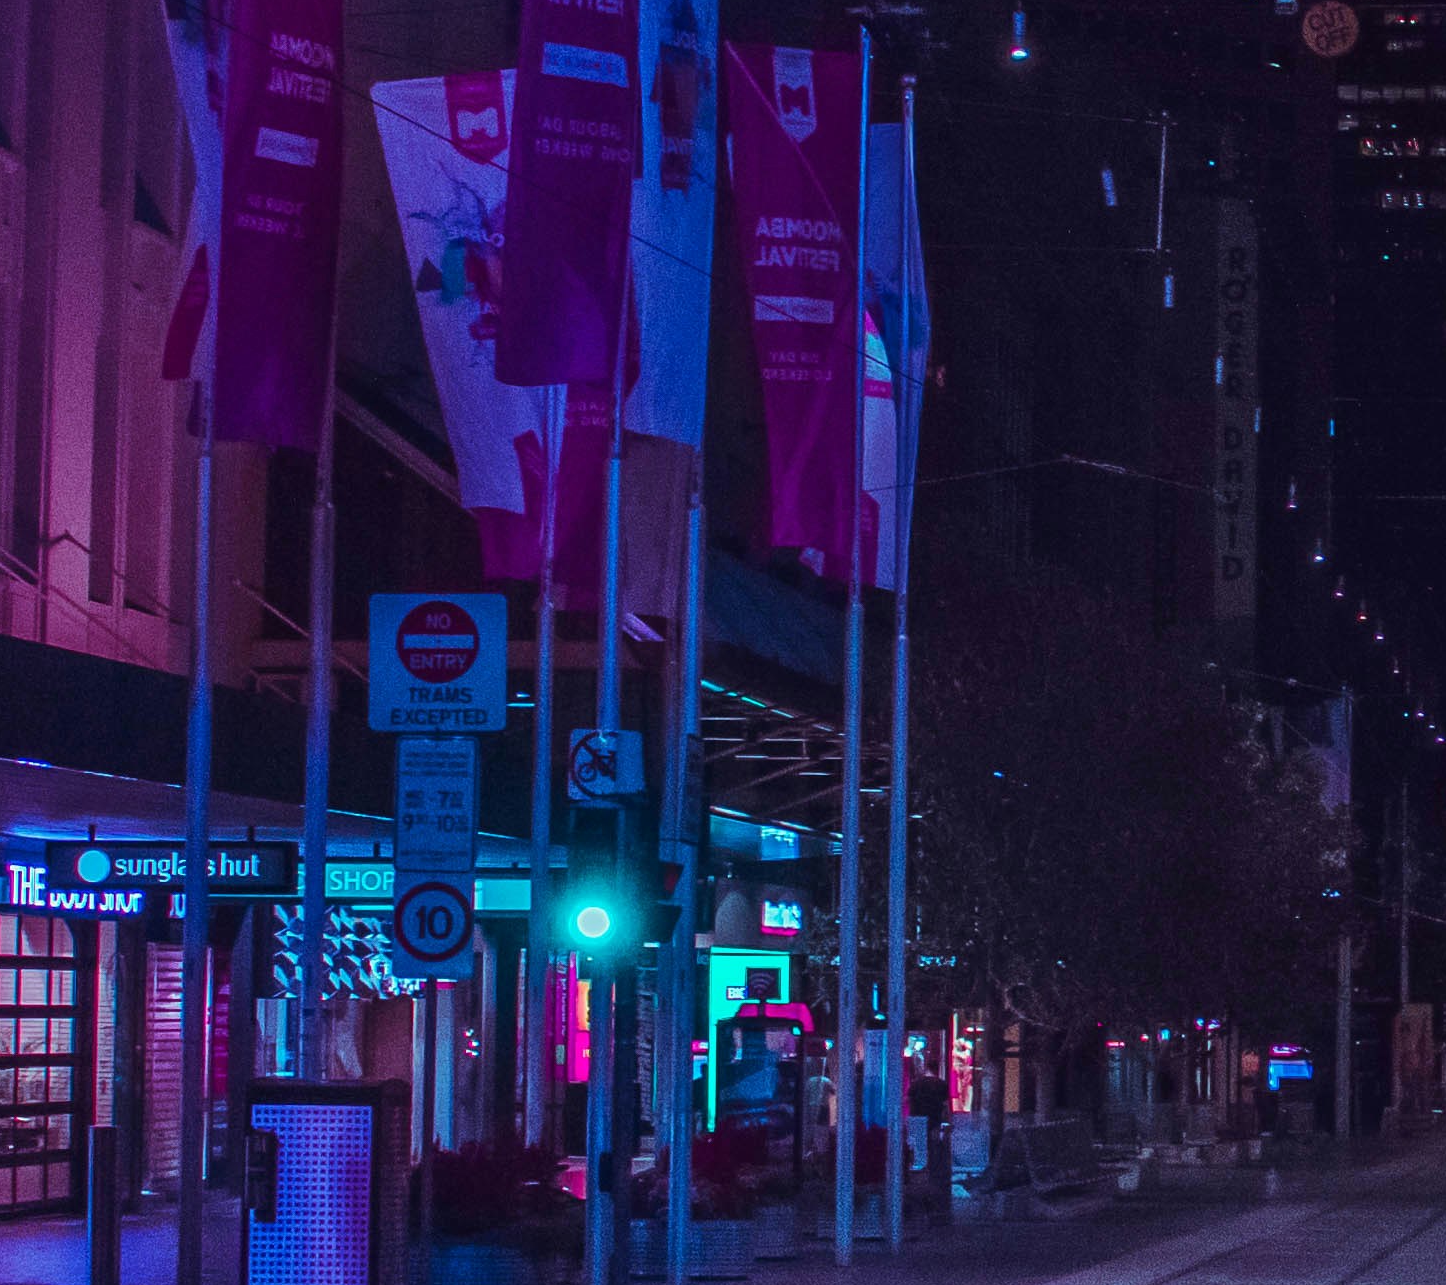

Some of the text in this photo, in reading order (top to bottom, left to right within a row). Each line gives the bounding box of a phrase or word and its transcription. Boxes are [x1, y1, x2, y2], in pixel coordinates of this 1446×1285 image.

[425, 613, 452, 630] NO
[409, 653, 468, 670] ENTRY
[409, 687, 474, 704] TRAMS
[391, 708, 488, 725] EXCEPTED
[114, 851, 262, 883] sunglas hut
[9, 864, 46, 906] THE
[417, 905, 453, 940] 10
